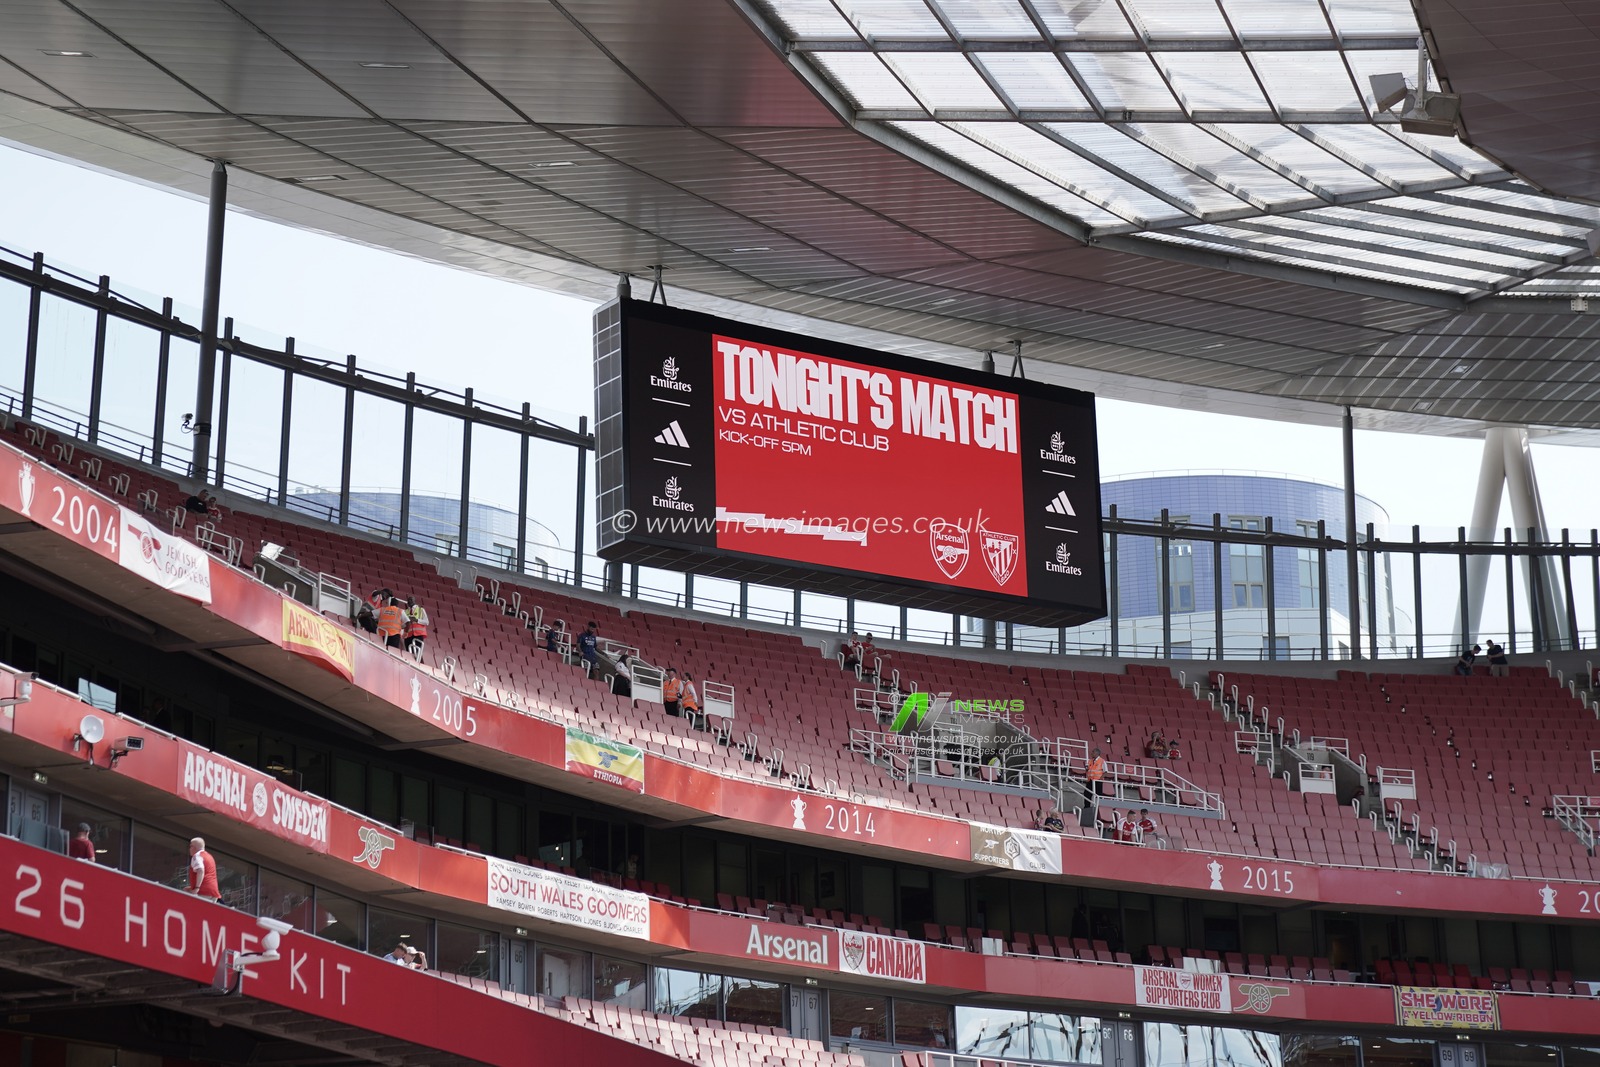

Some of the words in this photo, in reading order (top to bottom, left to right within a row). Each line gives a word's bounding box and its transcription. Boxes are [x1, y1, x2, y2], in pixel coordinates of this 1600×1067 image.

[650, 375, 692, 392] Emirates
[717, 341, 894, 430] TONIGHT'S
[900, 377, 1018, 454] MATCH
[718, 405, 746, 425] VS
[750, 412, 837, 442] ATHLETIC
[839, 429, 890, 451] CLUB
[719, 429, 779, 450] KICK-OFF
[1039, 449, 1076, 464] Emirates
[652, 495, 694, 512] Emirates
[51, 486, 118, 553] 2004
[936, 532, 964, 544] Arsenal
[982, 533, 1003, 541] ATHLETIC
[1045, 561, 1082, 576] Emirates
[432, 689, 477, 737] 2005
[593, 769, 623, 786] ETHIOPIA
[184, 751, 248, 812] ARSENAL
[272, 788, 327, 843] SWEDEN
[824, 804, 876, 838] 2014
[974, 853, 1010, 866] SUPPORTERS
[1242, 866, 1294, 894] 2015
[490, 873, 537, 901] SOUTH
[540, 884, 584, 911] WALES
[587, 896, 647, 924] GOONERS
[518, 901, 536, 912] BOWEN
[537, 906, 558, 917] ROBERTS
[15, 864, 85, 929] 26
[124, 896, 259, 980] HOME
[290, 948, 351, 1005] KIT
[745, 924, 829, 965] Arsenal
[866, 935, 923, 981] CANADA
[1142, 968, 1179, 988] ARSENAL
[1192, 973, 1223, 992] WOMEN
[808, 997, 818, 1010] 67
[1145, 986, 1200, 1008] SUPPORTERS
[1200, 991, 1221, 1010] CLUB
[1400, 991, 1437, 1008] SHE
[1439, 994, 1493, 1011] WORE
[1412, 1010, 1454, 1021] YELLOW
[1456, 1012, 1494, 1023] RIBBON
[1442, 1049, 1453, 1061] 69
[1464, 1050, 1475, 1062] 69
